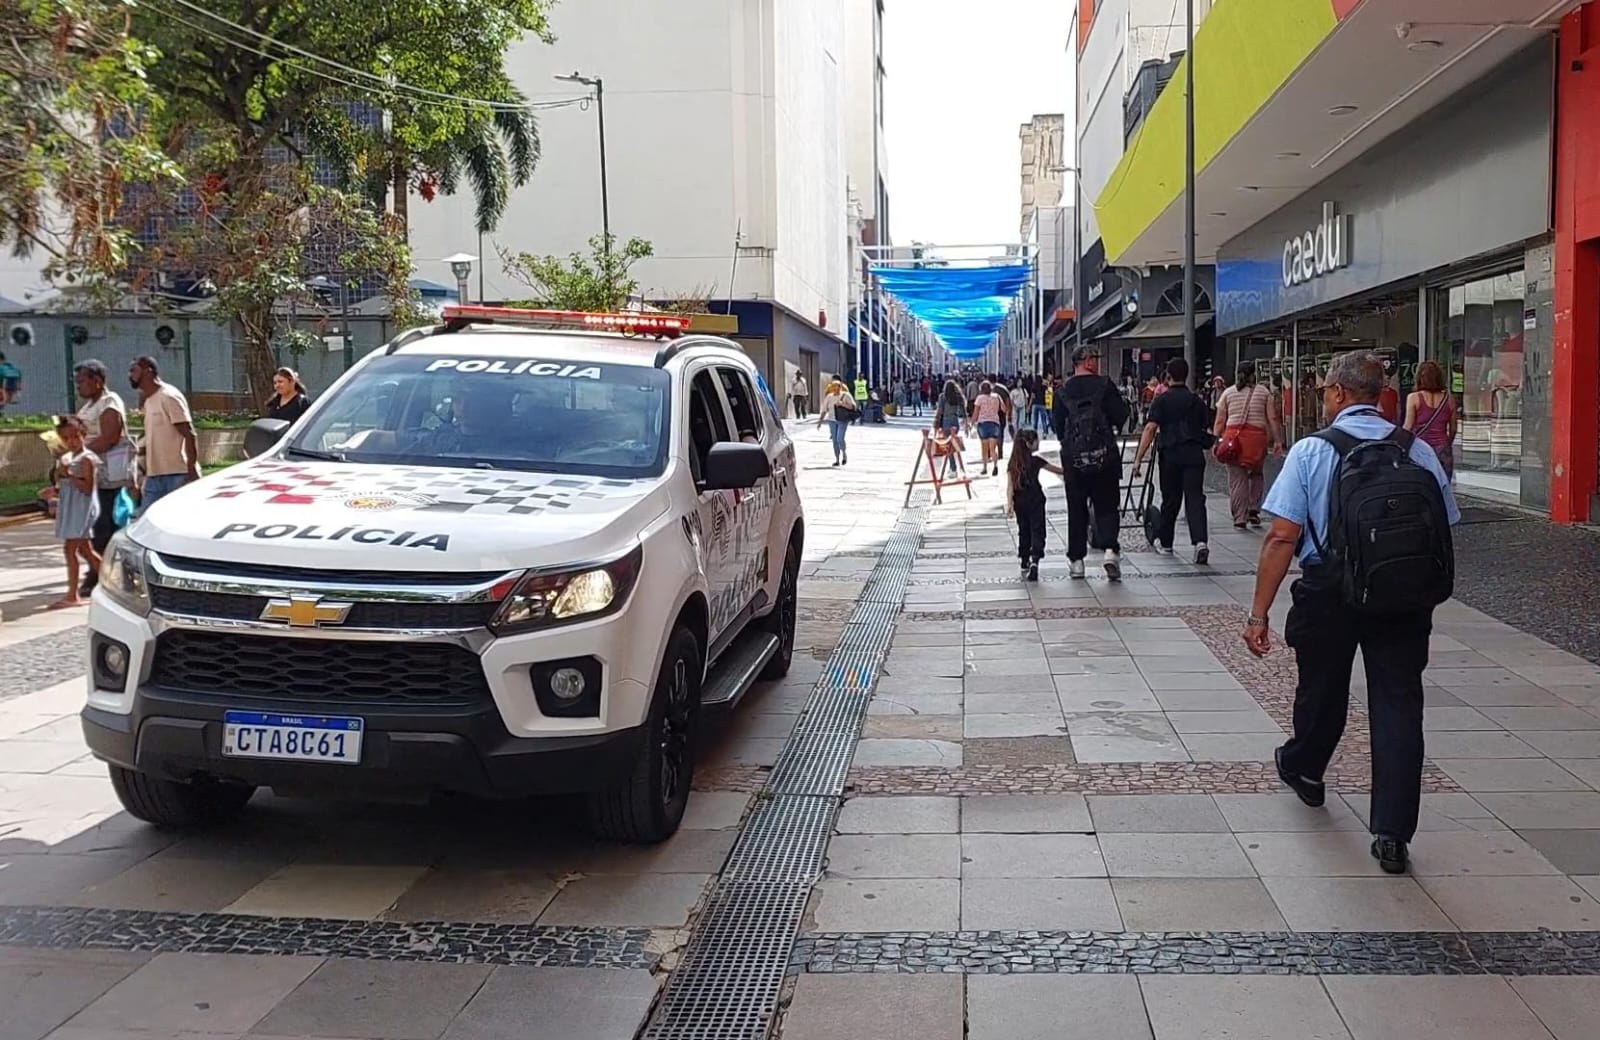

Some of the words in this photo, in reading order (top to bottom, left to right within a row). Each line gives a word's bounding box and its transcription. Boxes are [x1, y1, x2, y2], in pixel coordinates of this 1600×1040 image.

[1282, 201, 1346, 288] caedu
[425, 359, 601, 379] POLÍCIA
[212, 523, 450, 552] POLÍCIA
[281, 716, 303, 725] BRASIL
[237, 727, 346, 758] CTA8C61
